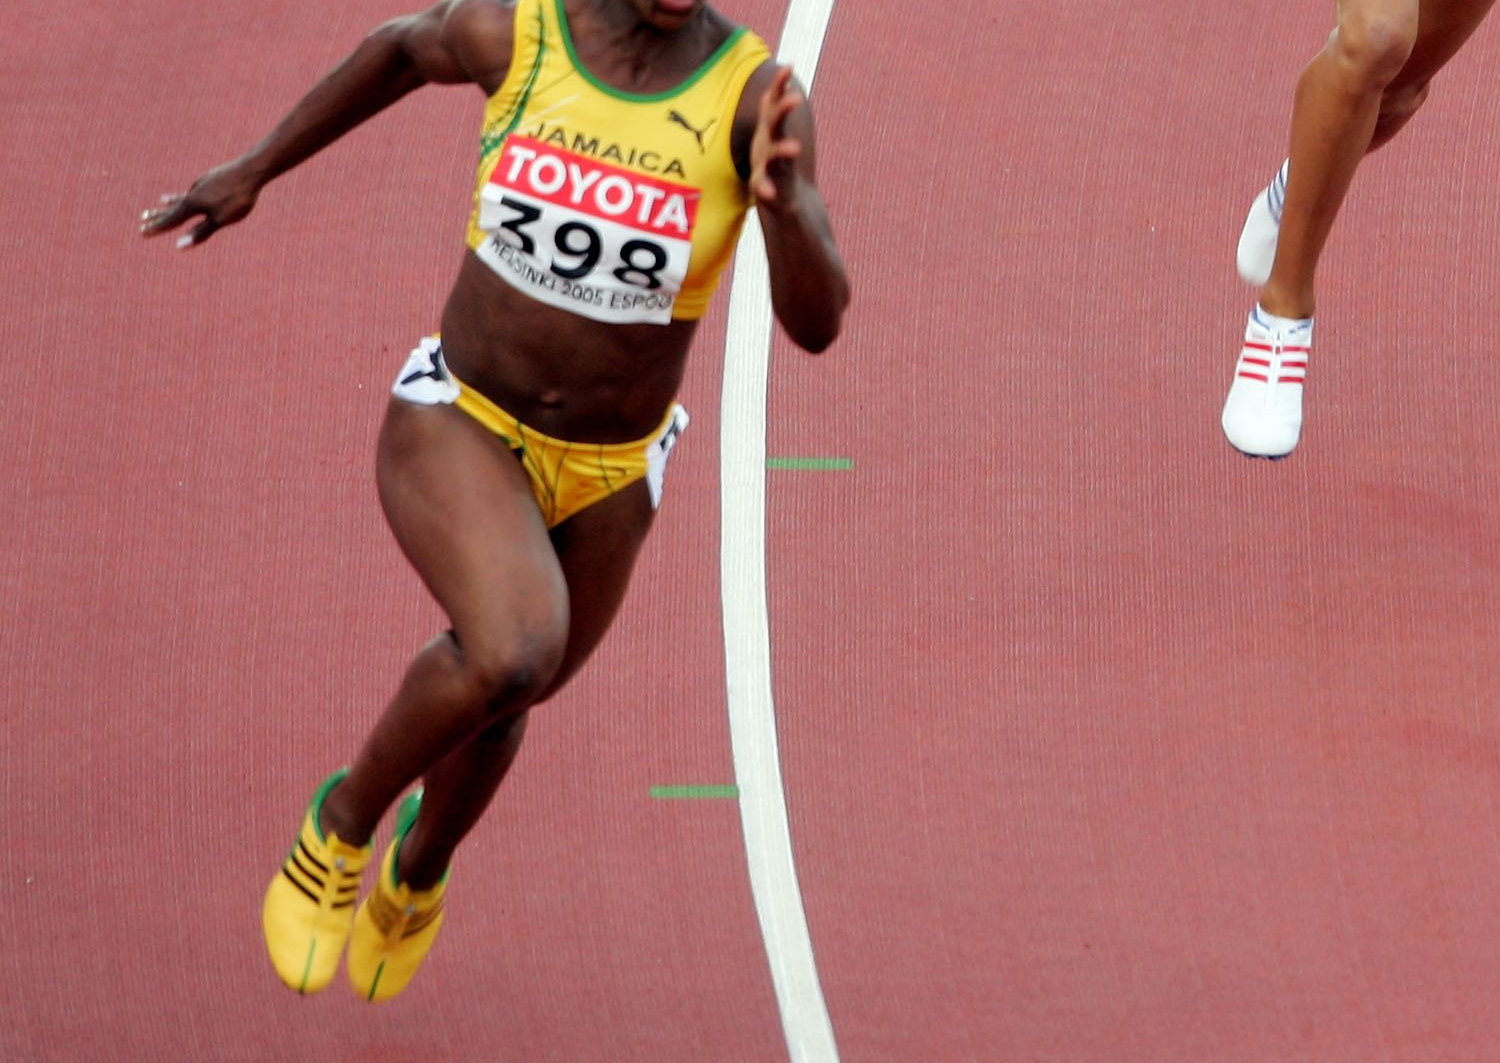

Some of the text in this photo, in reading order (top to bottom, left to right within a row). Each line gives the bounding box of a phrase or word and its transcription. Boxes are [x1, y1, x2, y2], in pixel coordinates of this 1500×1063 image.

[528, 123, 687, 178] JAMAICA
[505, 145, 690, 234] TOYOTA
[499, 194, 669, 290] 398
[559, 280, 604, 306] 2005
